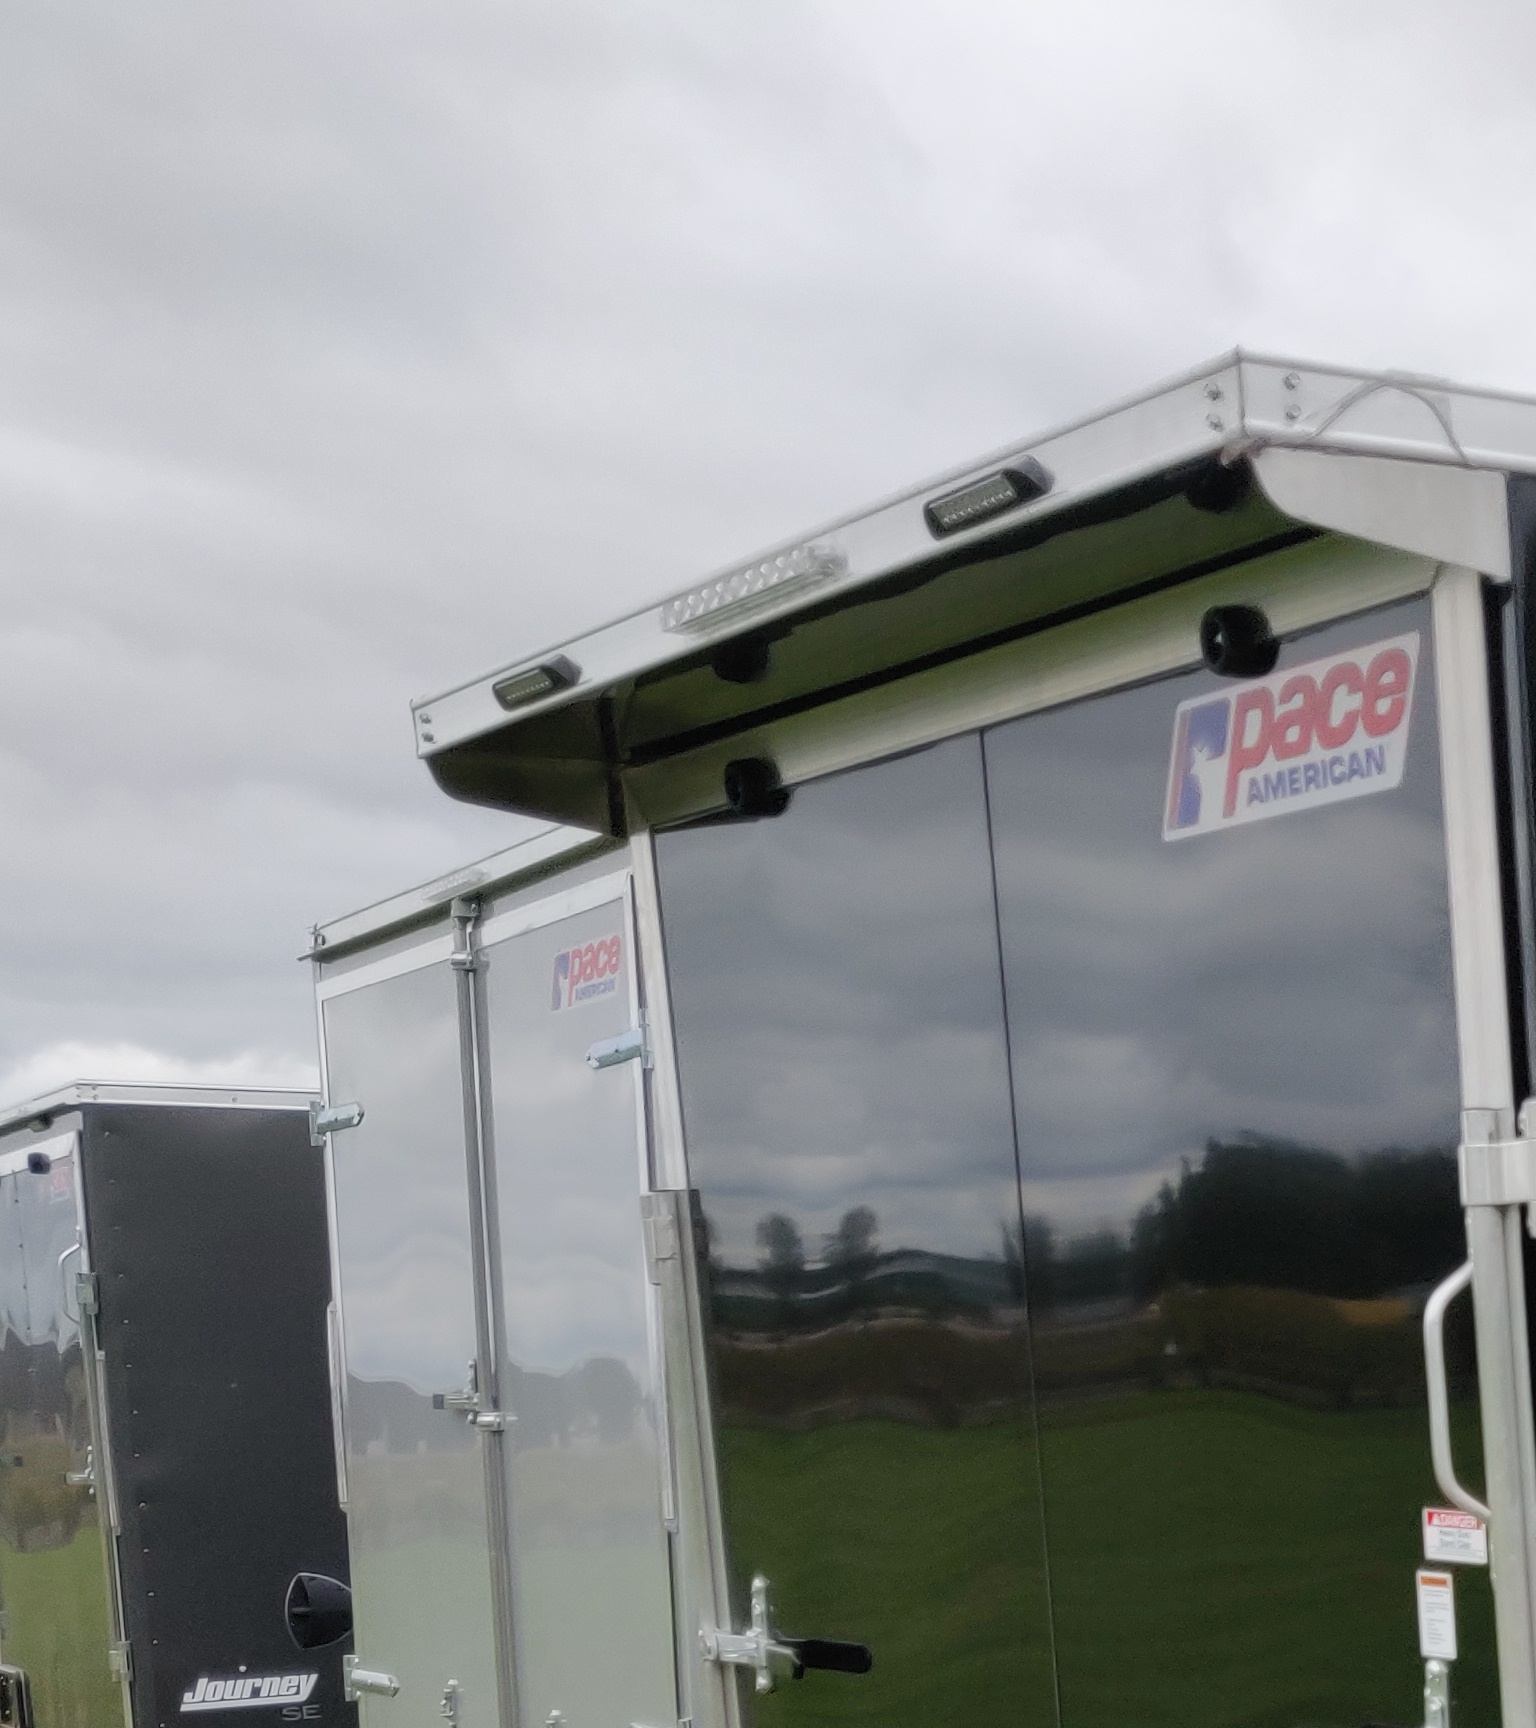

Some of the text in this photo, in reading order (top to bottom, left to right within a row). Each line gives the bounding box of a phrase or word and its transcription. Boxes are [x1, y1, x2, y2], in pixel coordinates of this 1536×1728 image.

[1222, 647, 1411, 819] pace
[1246, 744, 1387, 807] AMERICAN
[567, 934, 620, 1008] pace
[182, 1673, 318, 1704] Journey
[281, 1704, 322, 1721] SE
